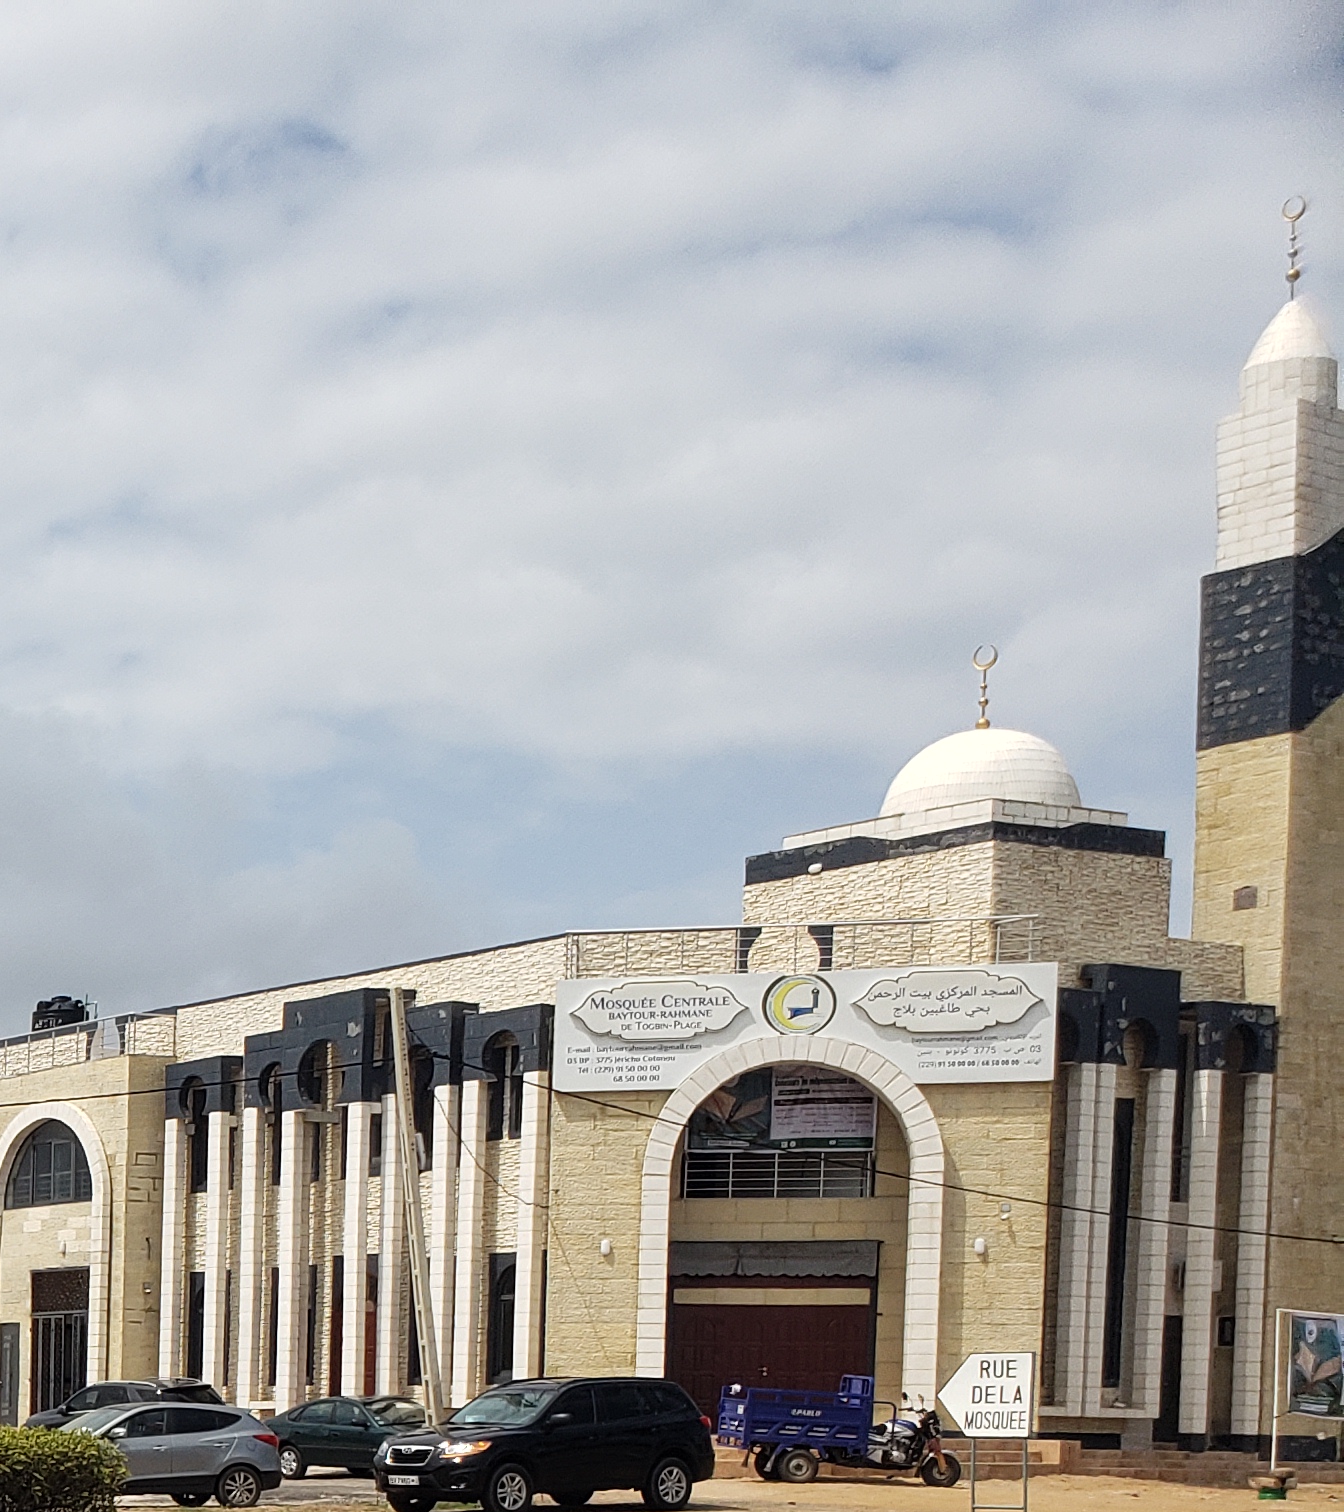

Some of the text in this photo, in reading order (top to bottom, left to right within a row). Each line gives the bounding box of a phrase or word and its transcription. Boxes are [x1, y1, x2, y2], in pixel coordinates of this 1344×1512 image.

[868, 985, 1023, 1002] المسجد المركزي بيت الرحمن
[893, 1003, 991, 1018] بحي طاغبين بلاج
[974, 1046, 996, 1054] 3775
[980, 1360, 1017, 1379] RUE
[964, 1411, 1027, 1431] MOSQUEE
